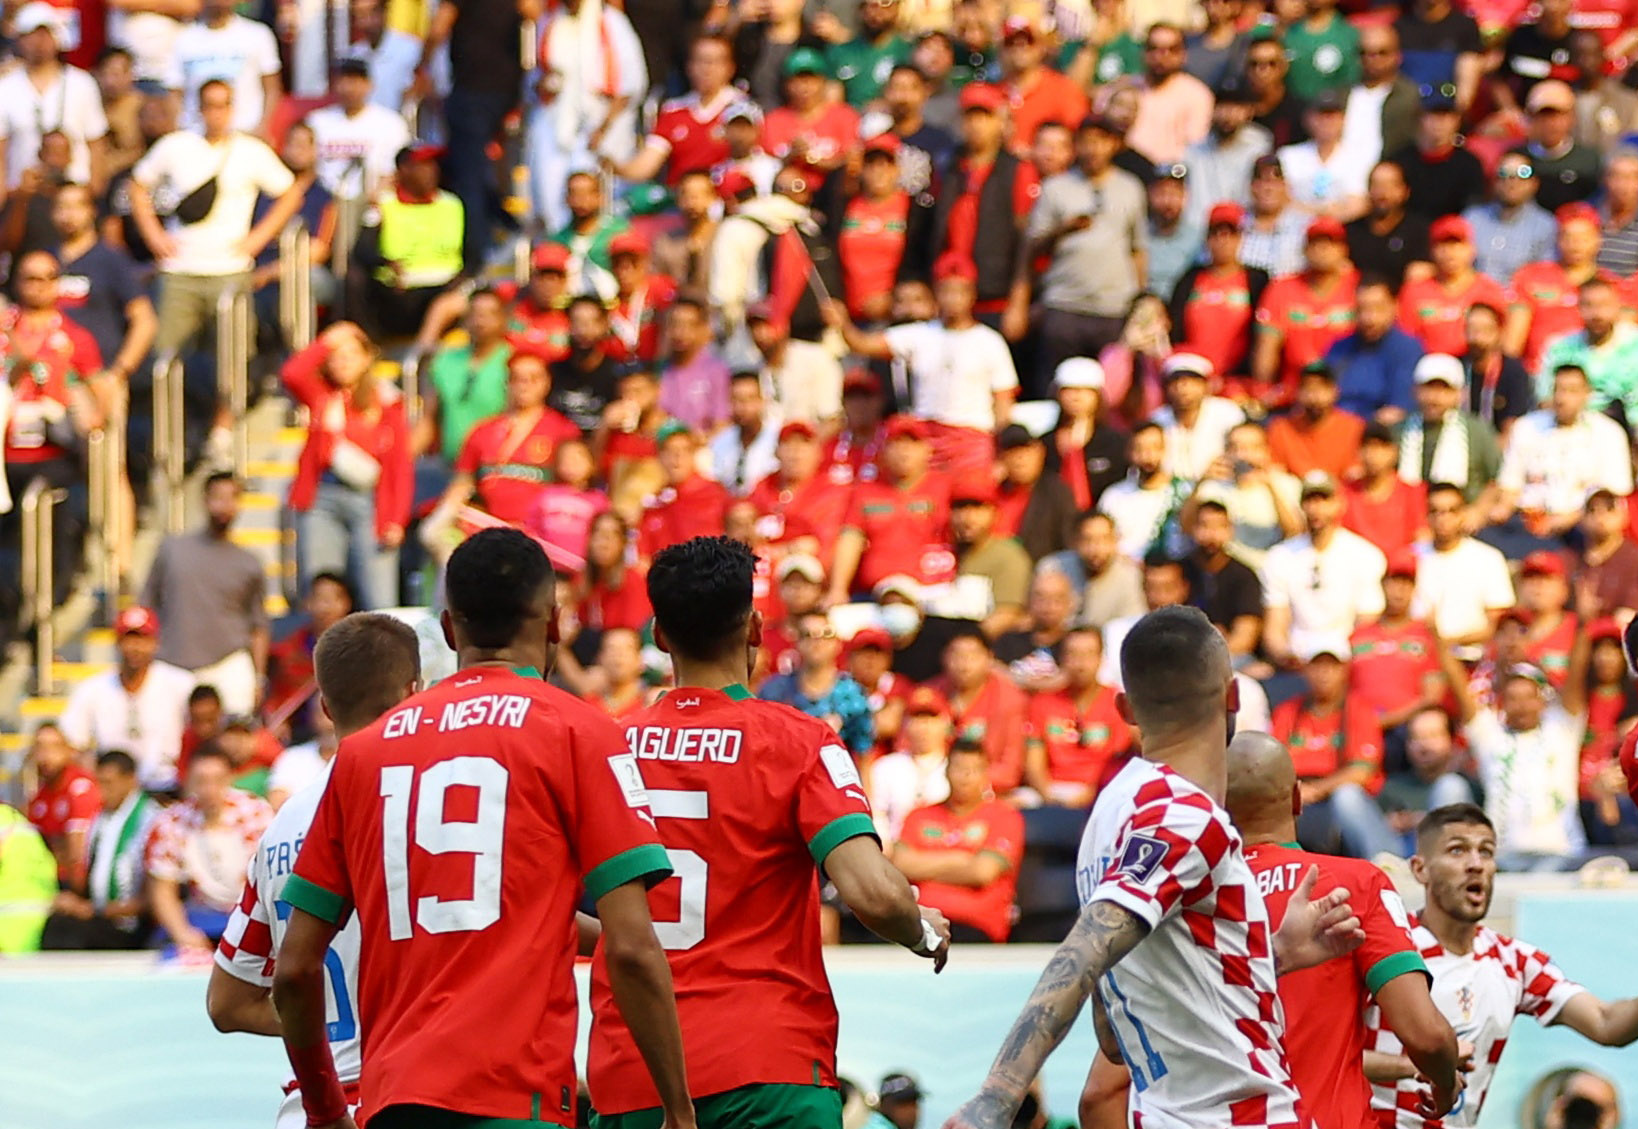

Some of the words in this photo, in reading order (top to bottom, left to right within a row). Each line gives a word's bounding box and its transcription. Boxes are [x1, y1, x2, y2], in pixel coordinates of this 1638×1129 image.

[379, 755, 510, 941] 19
[644, 789, 709, 950] 5
[1256, 862, 1302, 897] BAT
